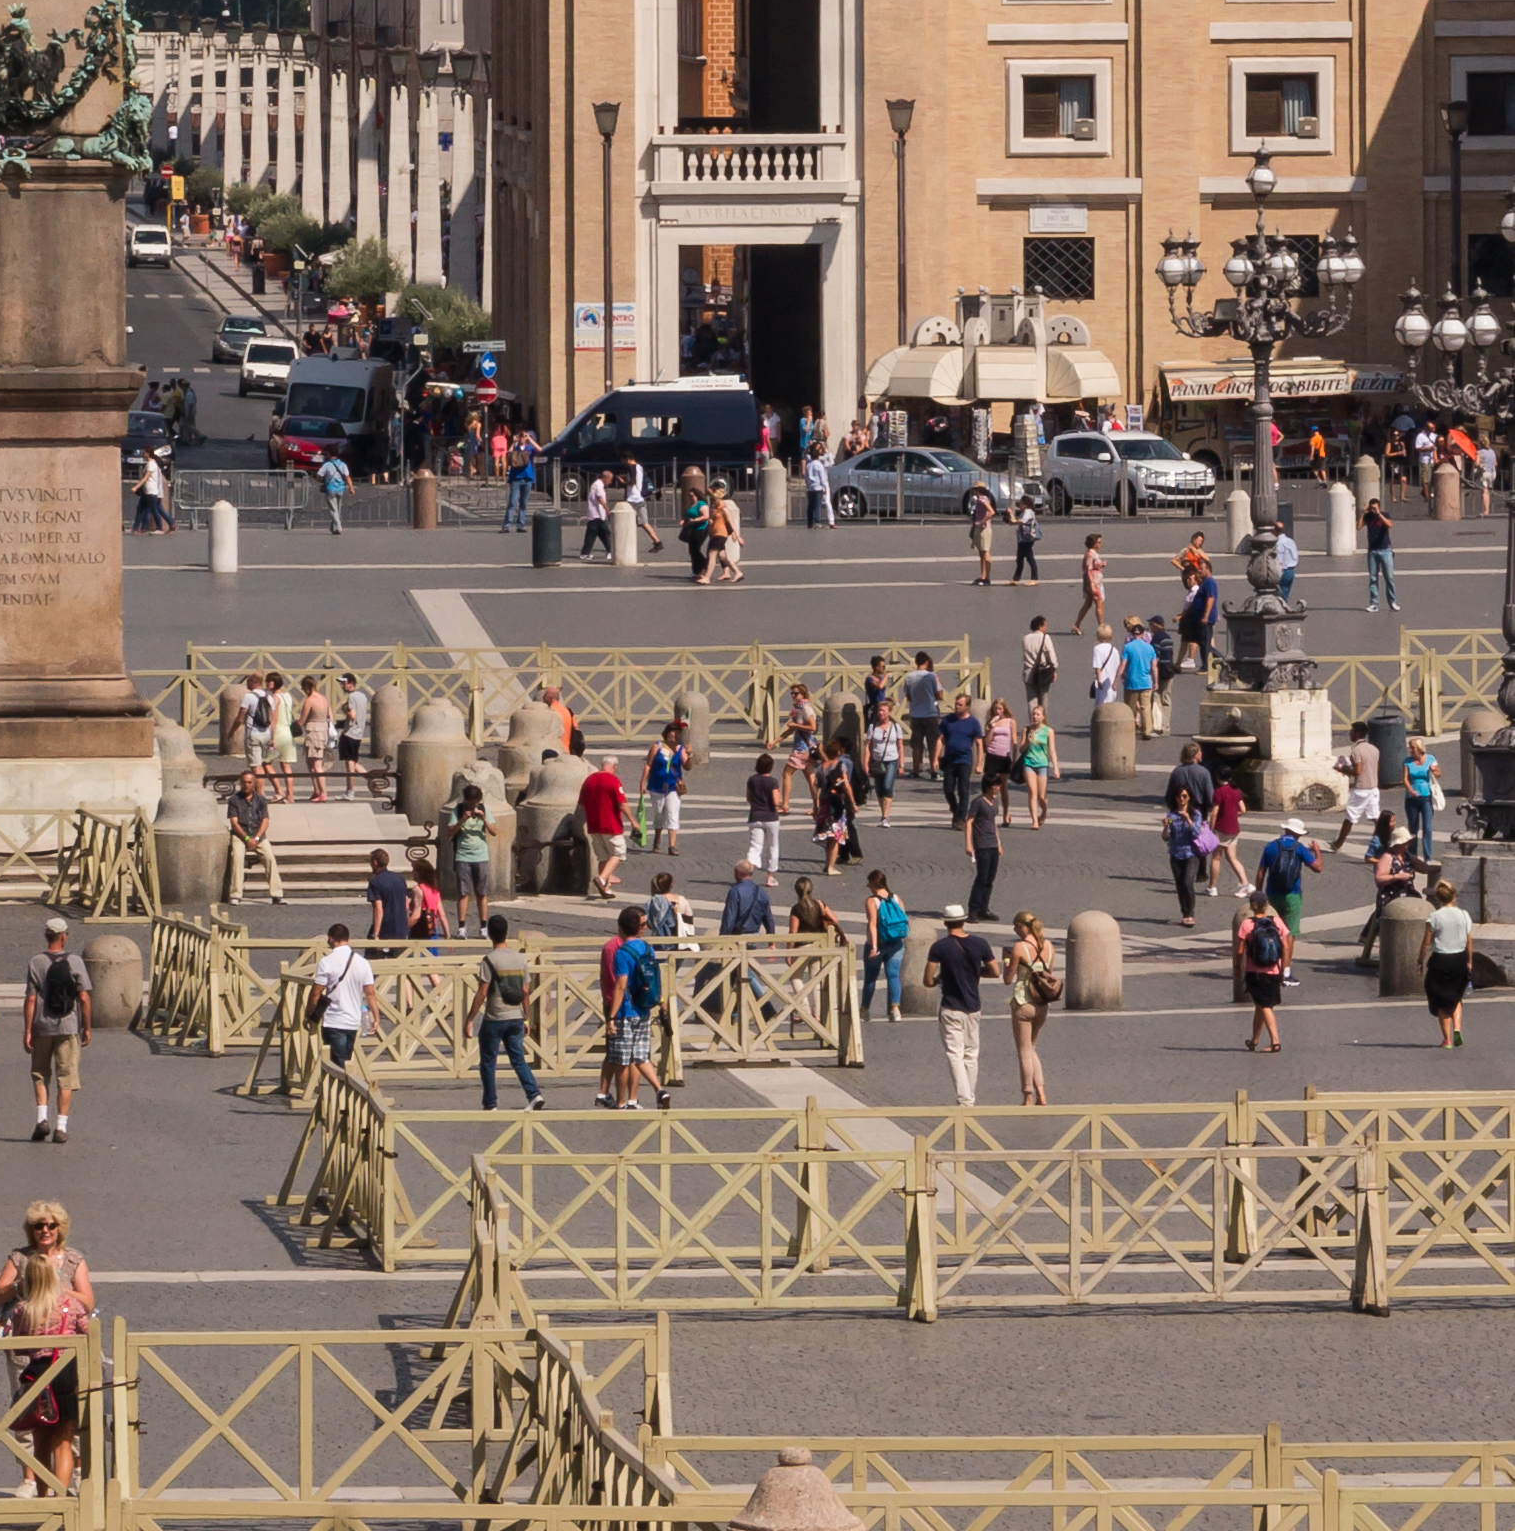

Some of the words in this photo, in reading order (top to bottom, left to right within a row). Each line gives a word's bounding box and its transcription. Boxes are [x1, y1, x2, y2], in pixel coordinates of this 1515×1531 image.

[1171, 382, 1216, 397] PANINI
[1297, 379, 1345, 393] BIBITE
[26, 487, 83, 503] VINCIT
[23, 510, 83, 524] REGNAT
[19, 531, 83, 545] IMPERAT
[1, 553, 20, 565] AB
[63, 551, 106, 564] MALO
[20, 573, 60, 585] SVAM
